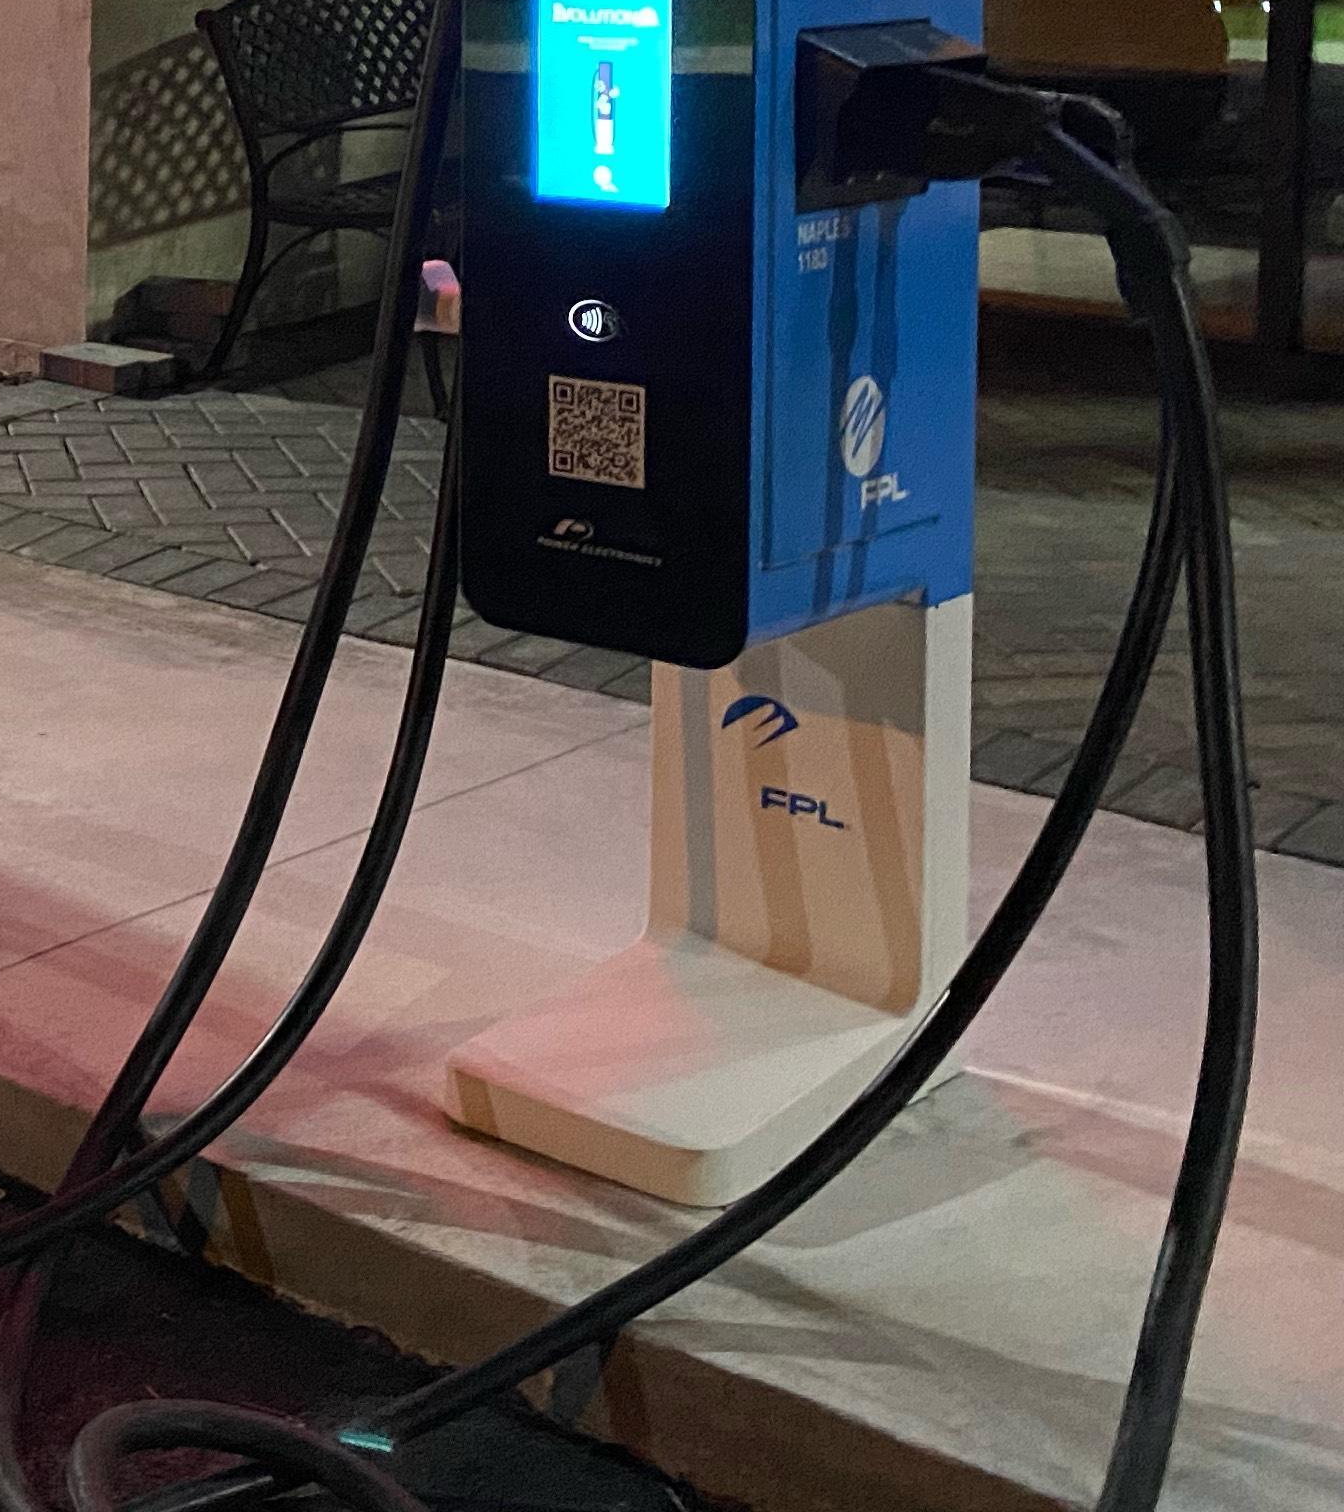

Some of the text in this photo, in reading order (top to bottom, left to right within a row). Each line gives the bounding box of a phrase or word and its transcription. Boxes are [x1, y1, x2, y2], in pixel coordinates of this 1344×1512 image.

[798, 216, 850, 245] NAPLES
[861, 472, 908, 510] FPL
[761, 785, 845, 830] FPL
